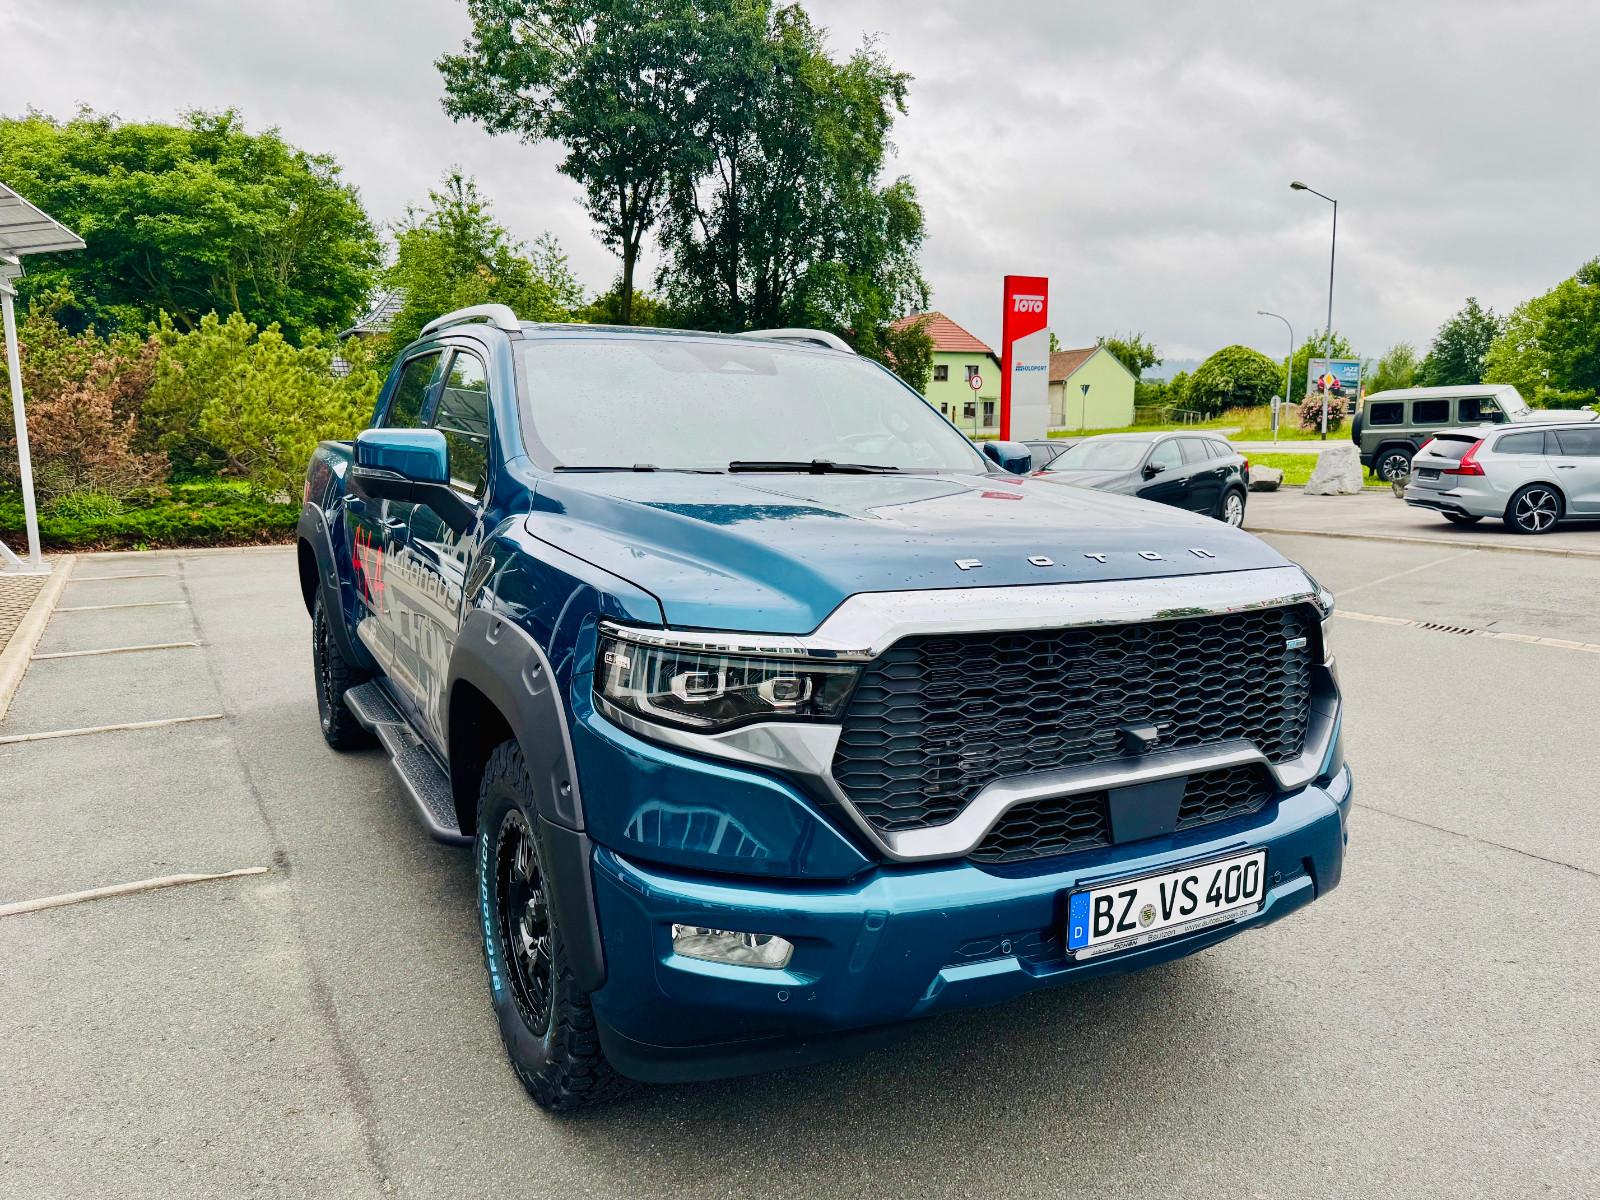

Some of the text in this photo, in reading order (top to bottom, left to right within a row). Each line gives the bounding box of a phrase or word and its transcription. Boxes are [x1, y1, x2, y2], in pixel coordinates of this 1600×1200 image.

[1092, 888, 1139, 939] BZ
[1159, 875, 1200, 921] VS
[1205, 859, 1260, 908] 400
[1074, 926, 1084, 939] D
